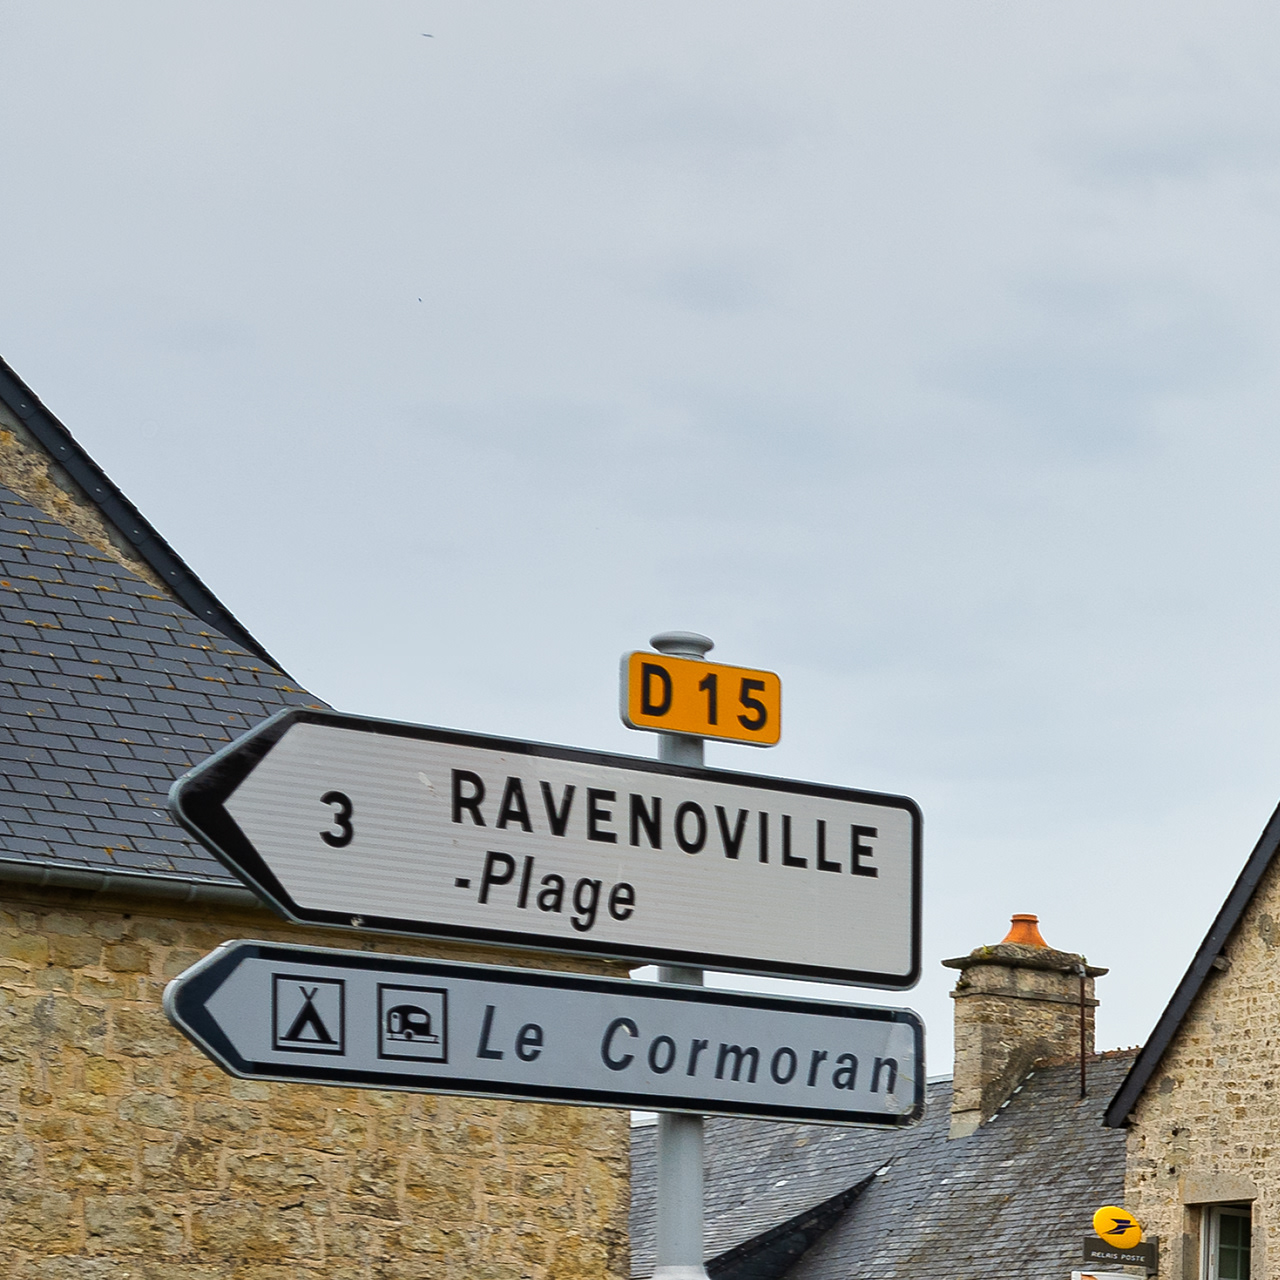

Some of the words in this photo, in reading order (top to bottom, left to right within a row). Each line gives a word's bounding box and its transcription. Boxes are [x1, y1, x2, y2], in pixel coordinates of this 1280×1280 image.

[640, 664, 673, 717] D
[699, 673, 769, 730] 15
[319, 791, 355, 848] 3
[450, 768, 880, 878] RAVENOVILLE
[477, 1005, 544, 1063] Le
[601, 1017, 899, 1095] Cormoran
[1091, 1251, 1118, 1261] RELAIS
[1120, 1254, 1146, 1263] POSTE
